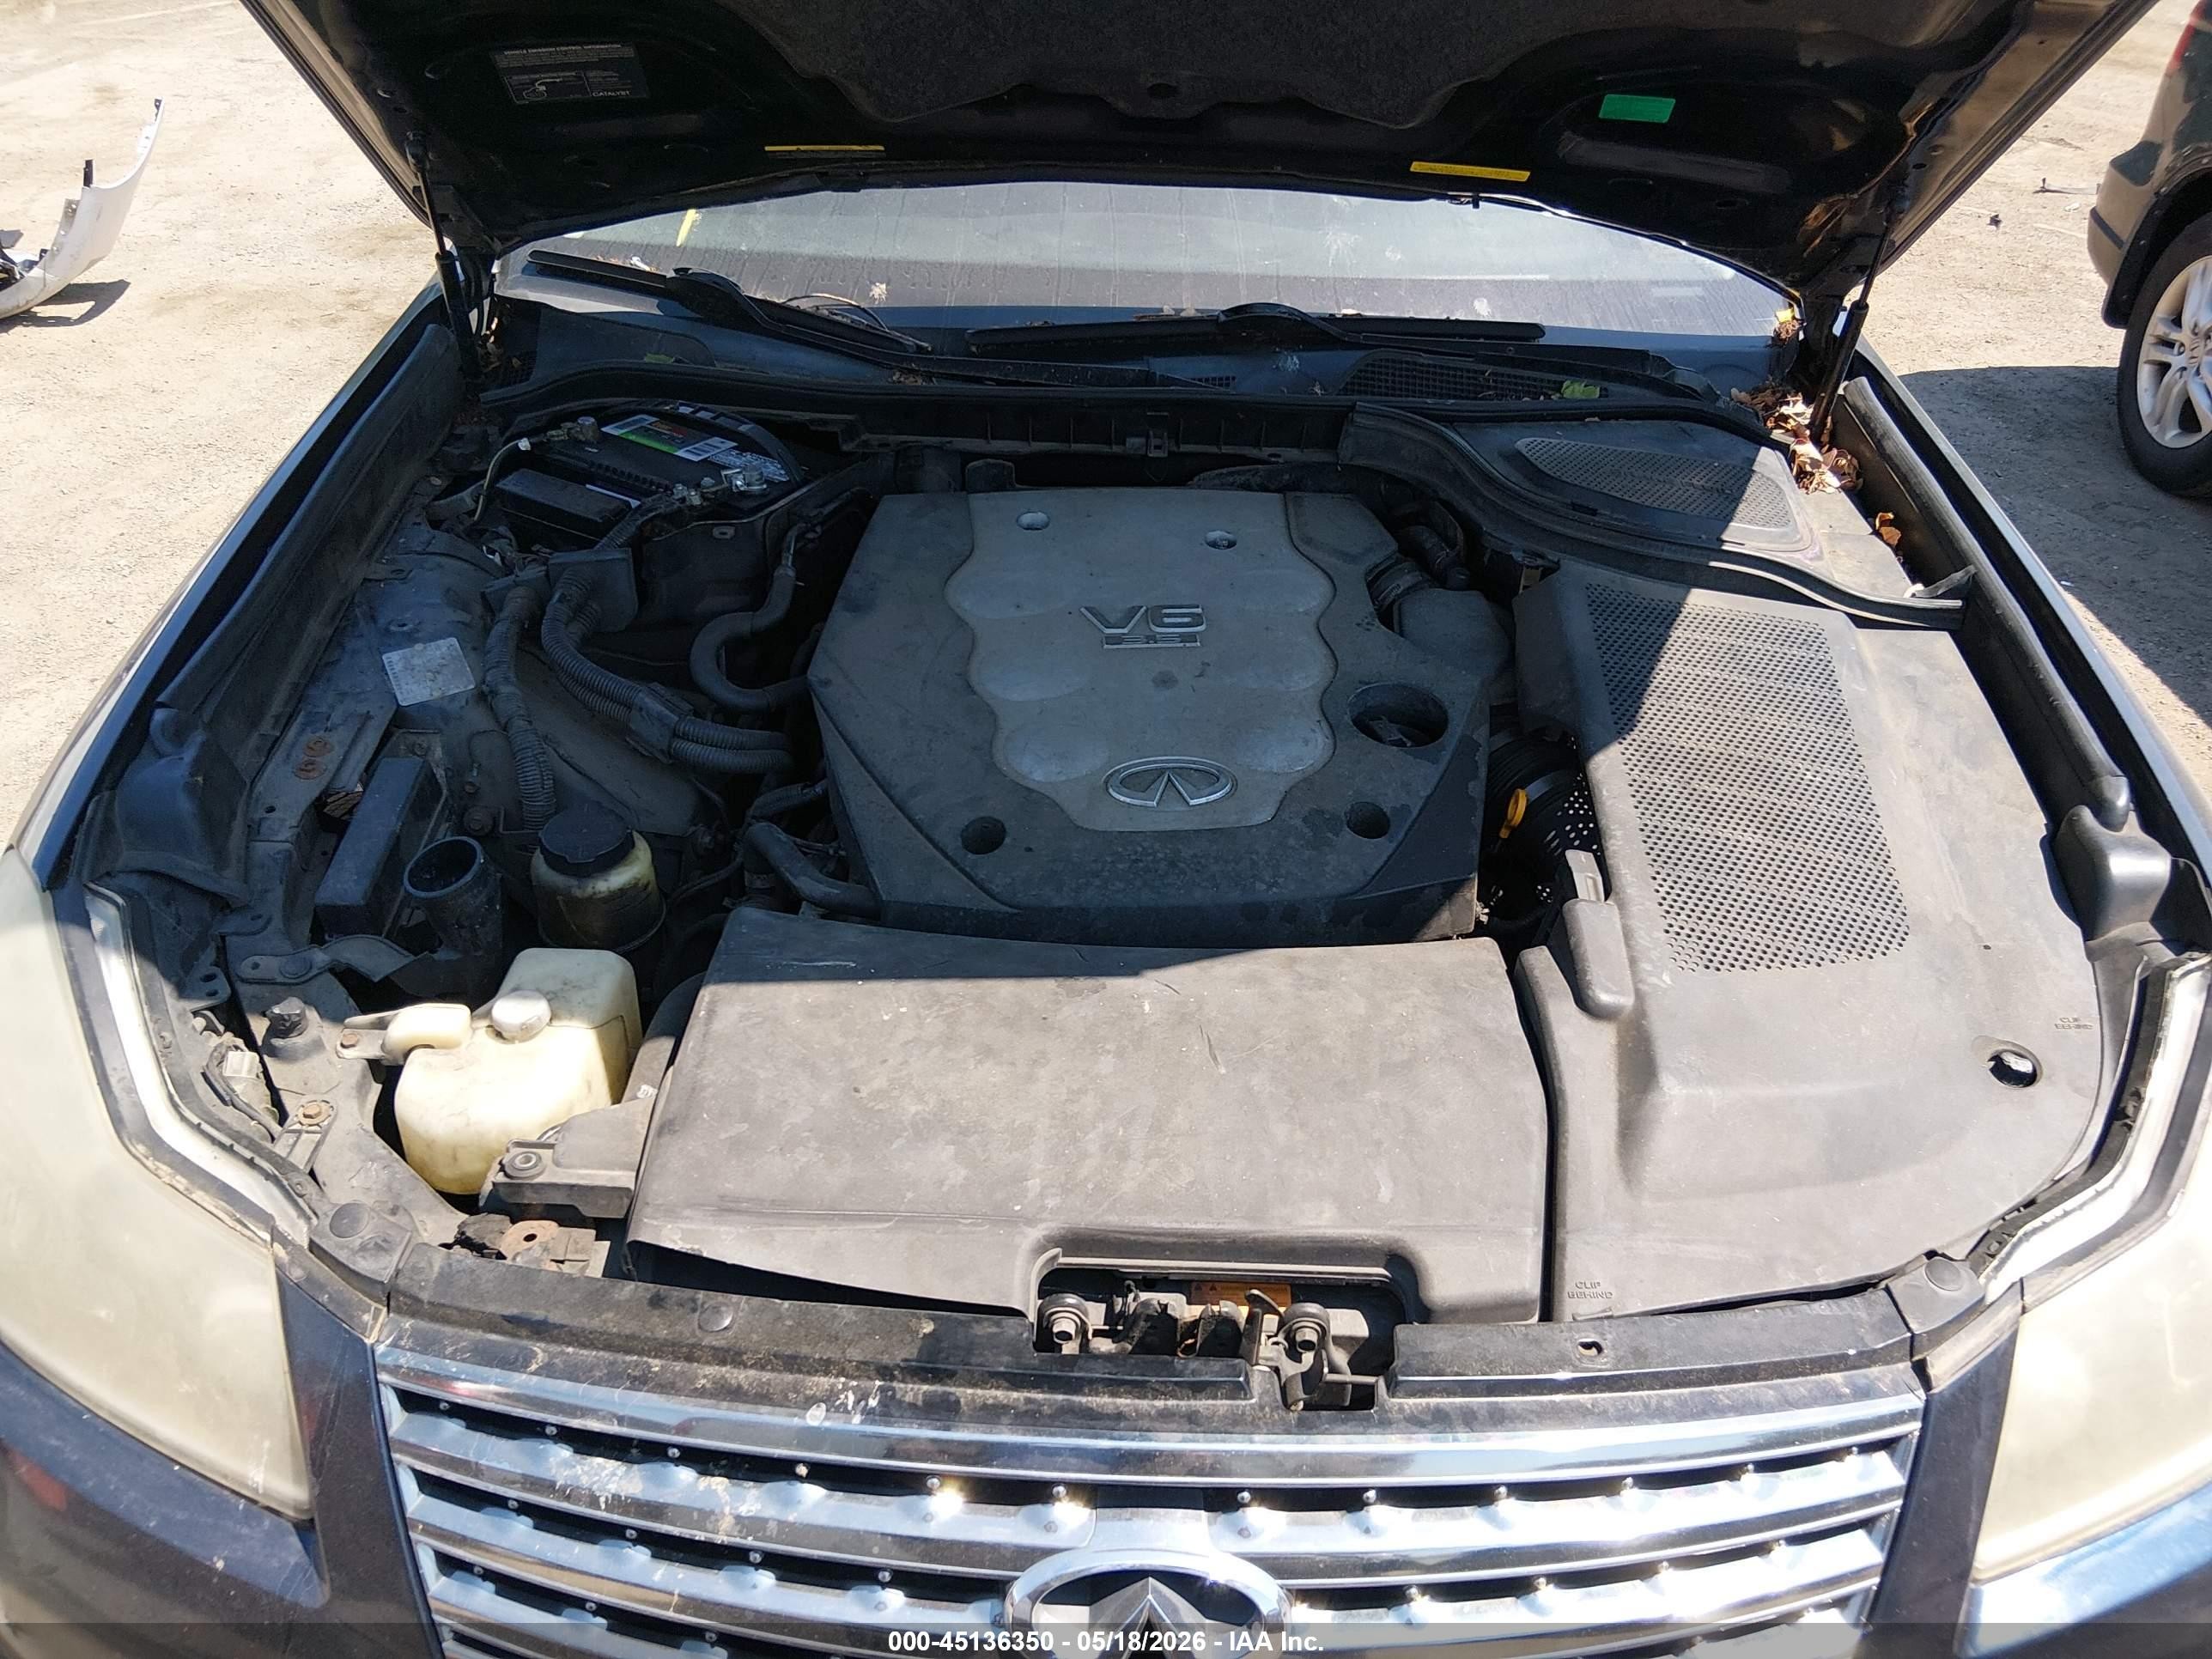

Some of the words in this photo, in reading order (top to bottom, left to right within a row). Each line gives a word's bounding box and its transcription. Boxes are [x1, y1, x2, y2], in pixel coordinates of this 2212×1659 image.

[1079, 605, 1207, 634] V6
[1121, 635, 1182, 645] 3.5
[1574, 1280, 1601, 1290] CLIP
[1567, 1291, 1613, 1299] BEHIND
